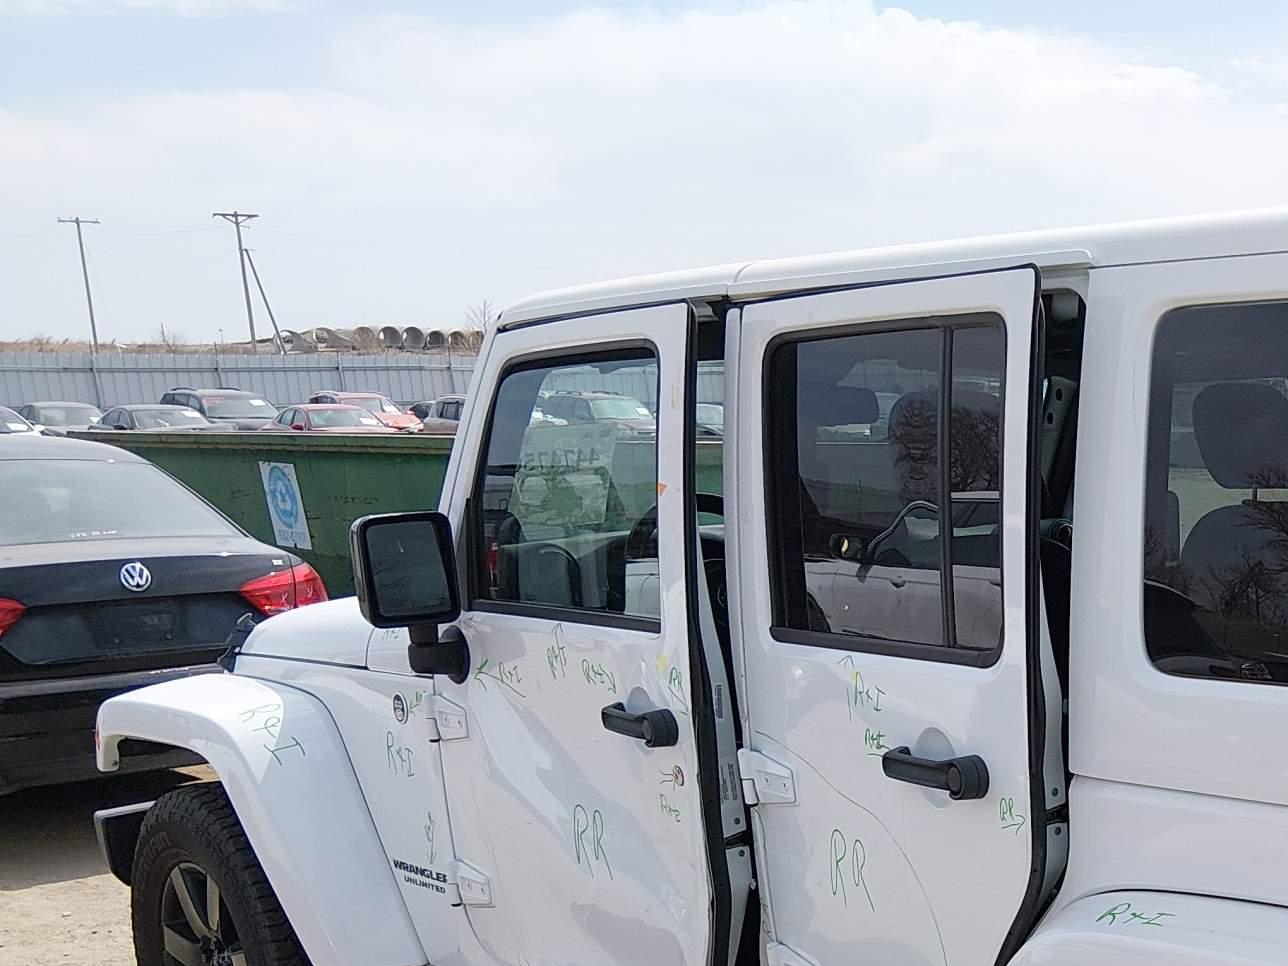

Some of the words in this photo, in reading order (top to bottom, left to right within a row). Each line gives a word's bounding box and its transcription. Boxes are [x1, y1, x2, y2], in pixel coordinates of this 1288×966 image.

[573, 804, 613, 880] RR
[393, 859, 448, 883] WRANGLER
[404, 875, 446, 894] UNLIMITED
[830, 828, 875, 913] RR
